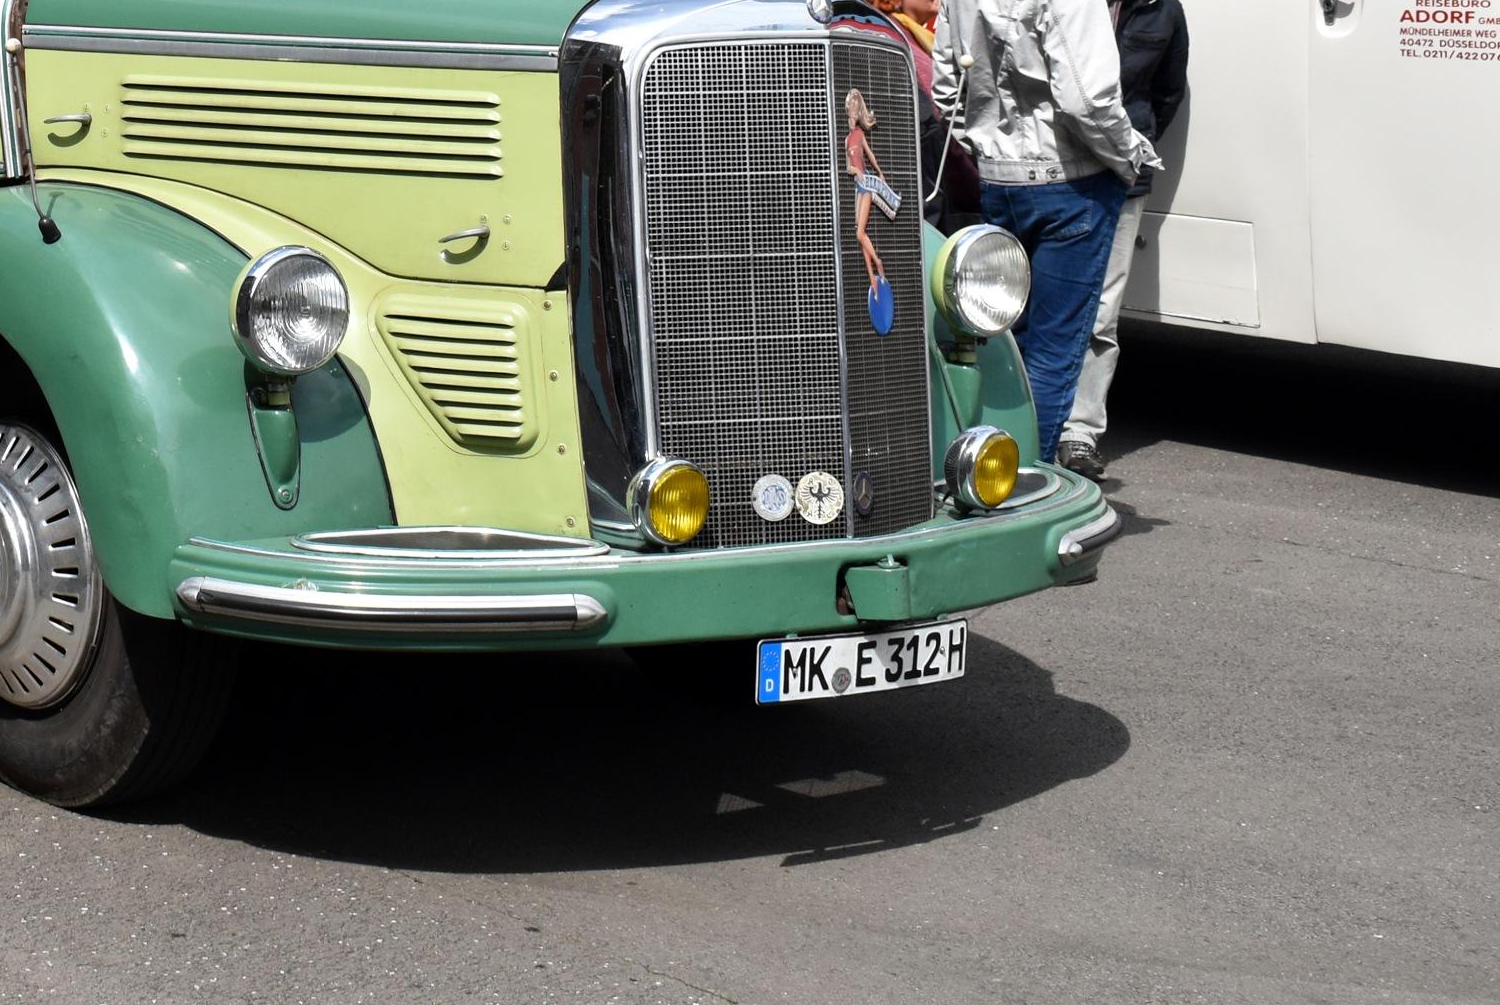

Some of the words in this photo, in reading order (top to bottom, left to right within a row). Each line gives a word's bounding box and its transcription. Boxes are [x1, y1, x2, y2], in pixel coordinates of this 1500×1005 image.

[1400, 9, 1475, 24] ADORF
[1400, 26, 1472, 37] MÜNDELHEIMER
[1474, 29, 1497, 38] WEG
[1400, 38, 1434, 47] 40472
[765, 678, 774, 692] D
[783, 645, 832, 694] MK
[855, 640, 877, 687] E
